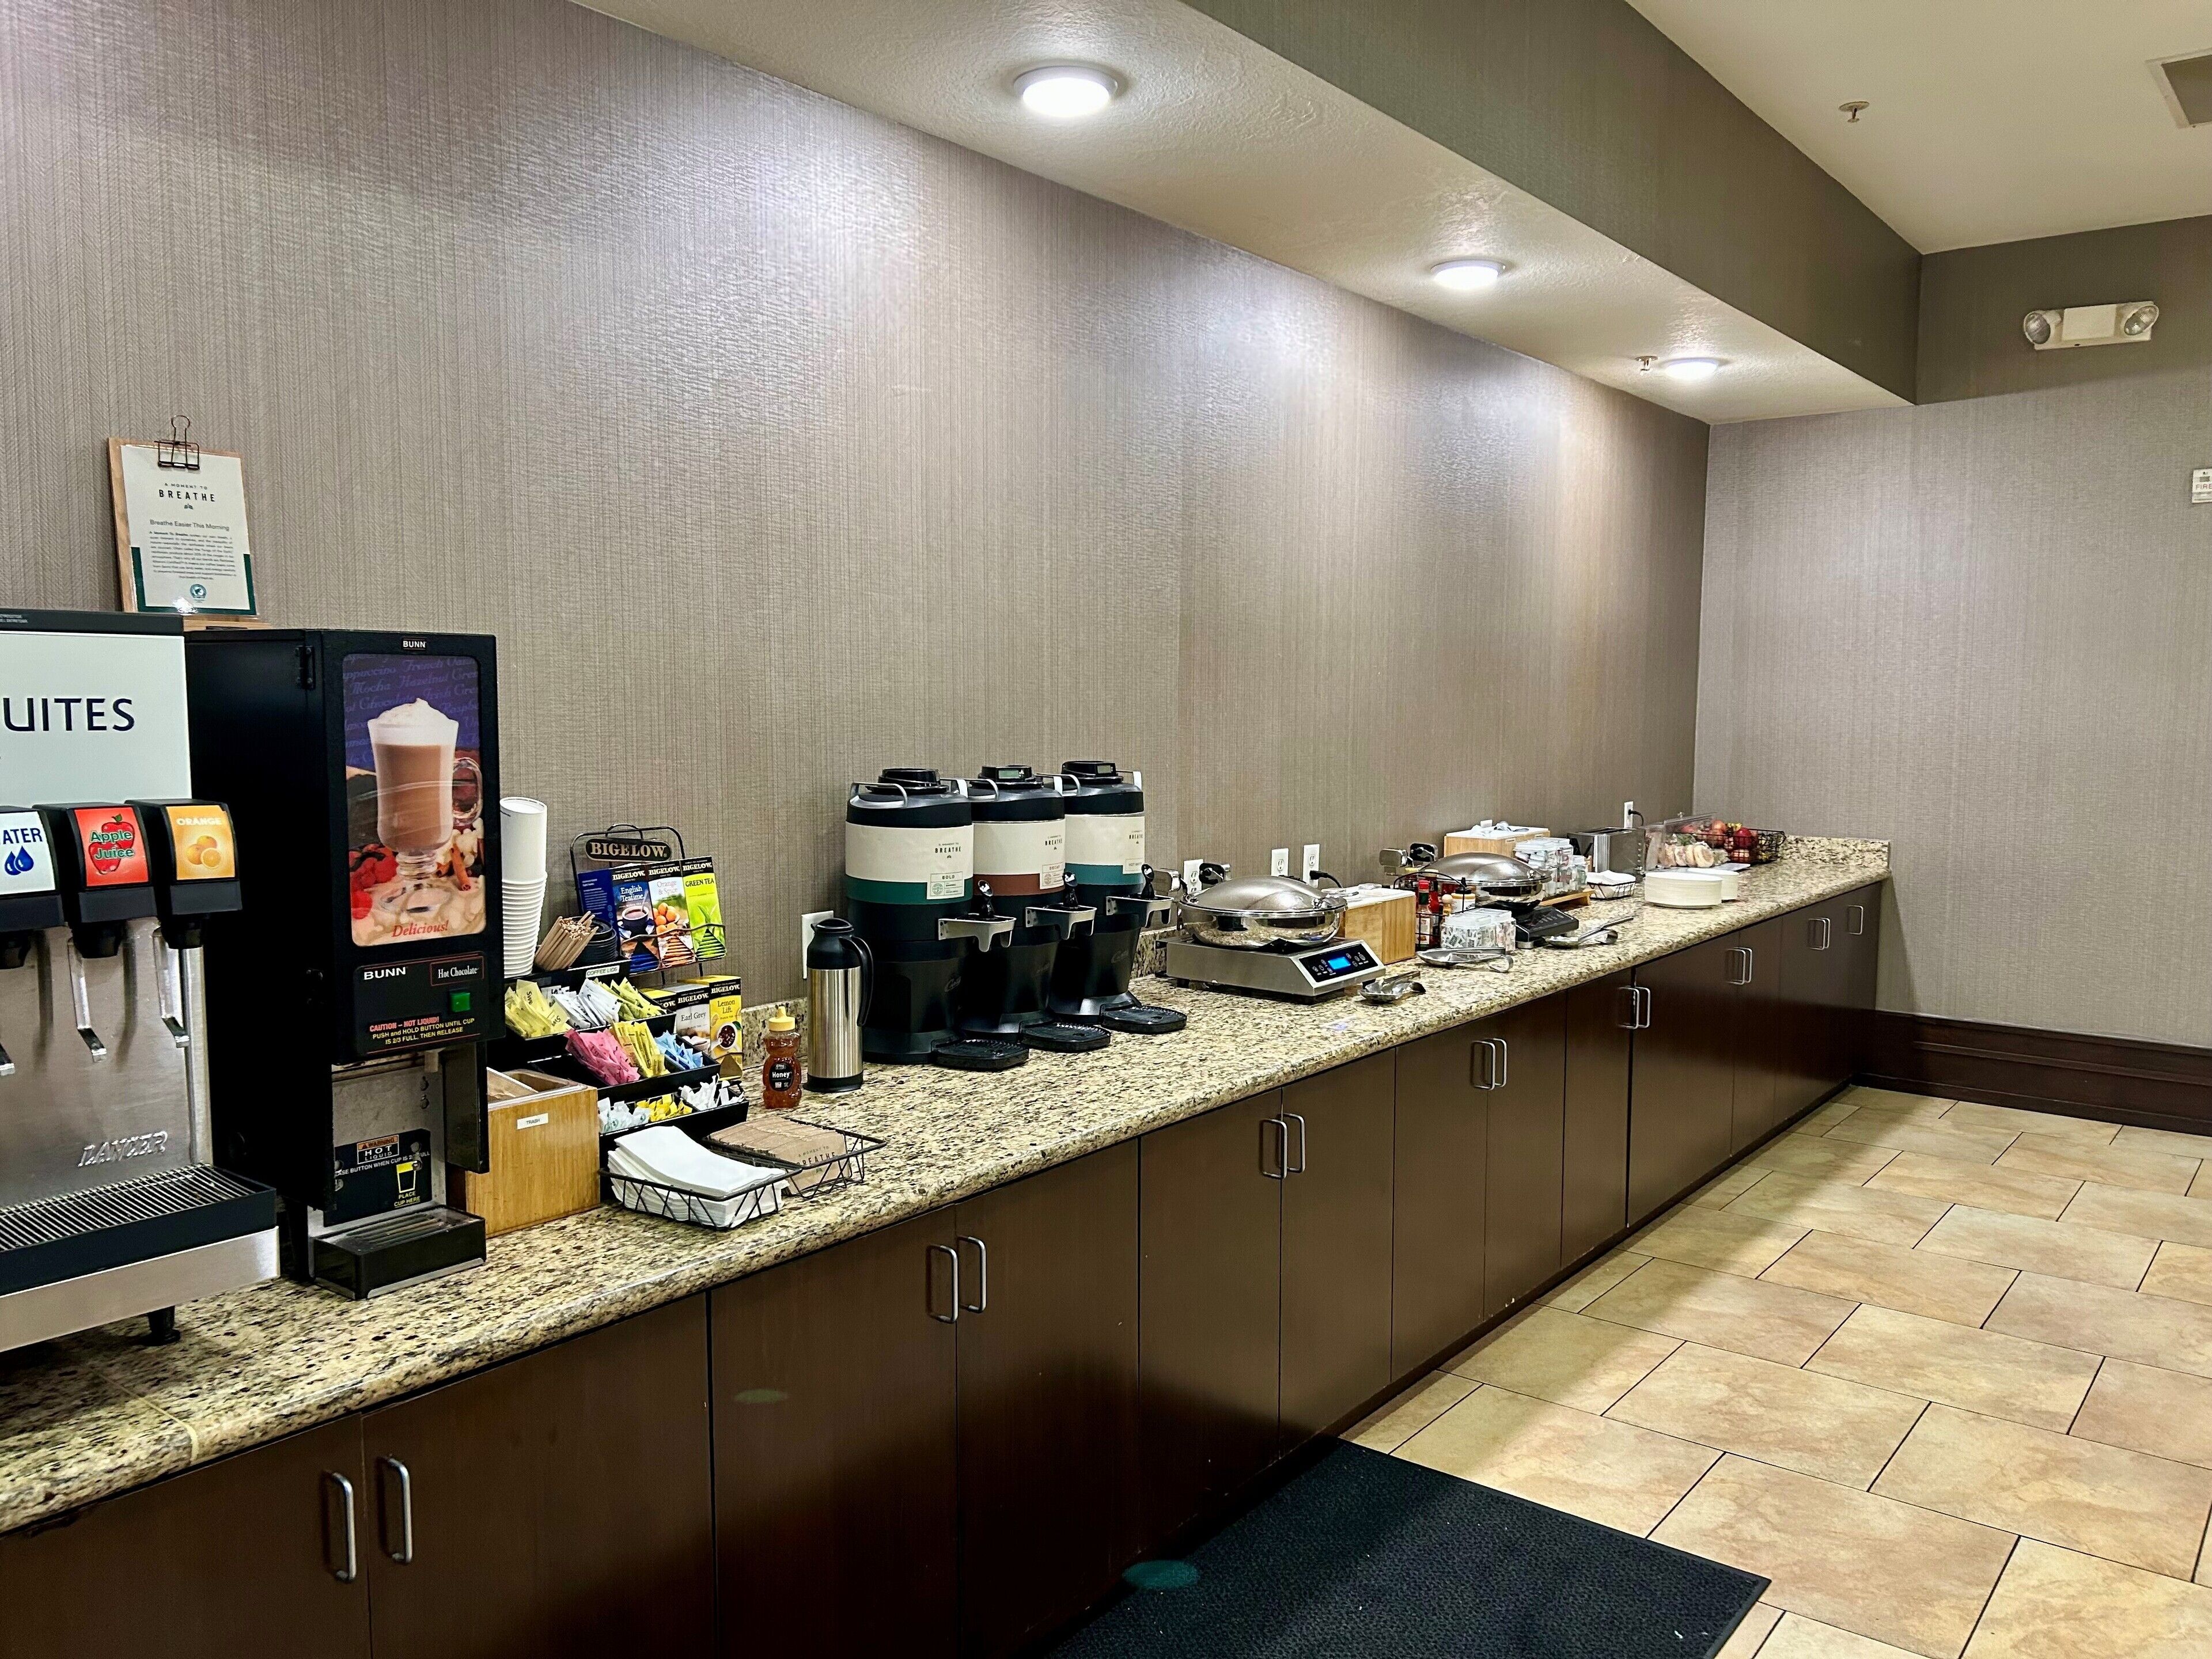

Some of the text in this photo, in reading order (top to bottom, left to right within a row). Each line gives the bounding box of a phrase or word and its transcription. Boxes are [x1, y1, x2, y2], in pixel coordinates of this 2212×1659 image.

[158, 489, 215, 502] BREATHE
[206, 524, 230, 532] Morning
[3, 698, 135, 732] UITES
[176, 817, 222, 825] ORANGE
[3, 828, 43, 844] ATER
[90, 830, 133, 843] Apple
[94, 848, 134, 859] Juice
[589, 842, 668, 858] BIGELOW
[649, 866, 680, 876] BIGELOW
[683, 862, 713, 871] BIGELOW
[612, 870, 645, 881] BIGELOW
[620, 885, 642, 895] English
[620, 894, 645, 902] Teatime
[392, 920, 449, 937] Delicious!
[363, 967, 406, 980] BUNN
[438, 965, 478, 978] Hot Chocolate
[711, 984, 740, 994] BIGELOW
[677, 993, 709, 1003] BIGELOW
[717, 999, 735, 1007] Lemon
[722, 1006, 732, 1014] Lift
[681, 1013, 692, 1021] Earl
[369, 1022, 397, 1032] CAUTION
[404, 1019, 416, 1028] HOT
[417, 1016, 440, 1026] LIQUID!
[421, 1024, 444, 1032] BUTTON
[437, 1027, 463, 1036] RELEASE
[772, 1071, 791, 1080] Honey
[368, 1138, 395, 1147] WARNING
[365, 1145, 392, 1156] HOT
[365, 1152, 392, 1161] LIQUID
[350, 1164, 372, 1173] BUTTON
[398, 1191, 416, 1199] PLACE
